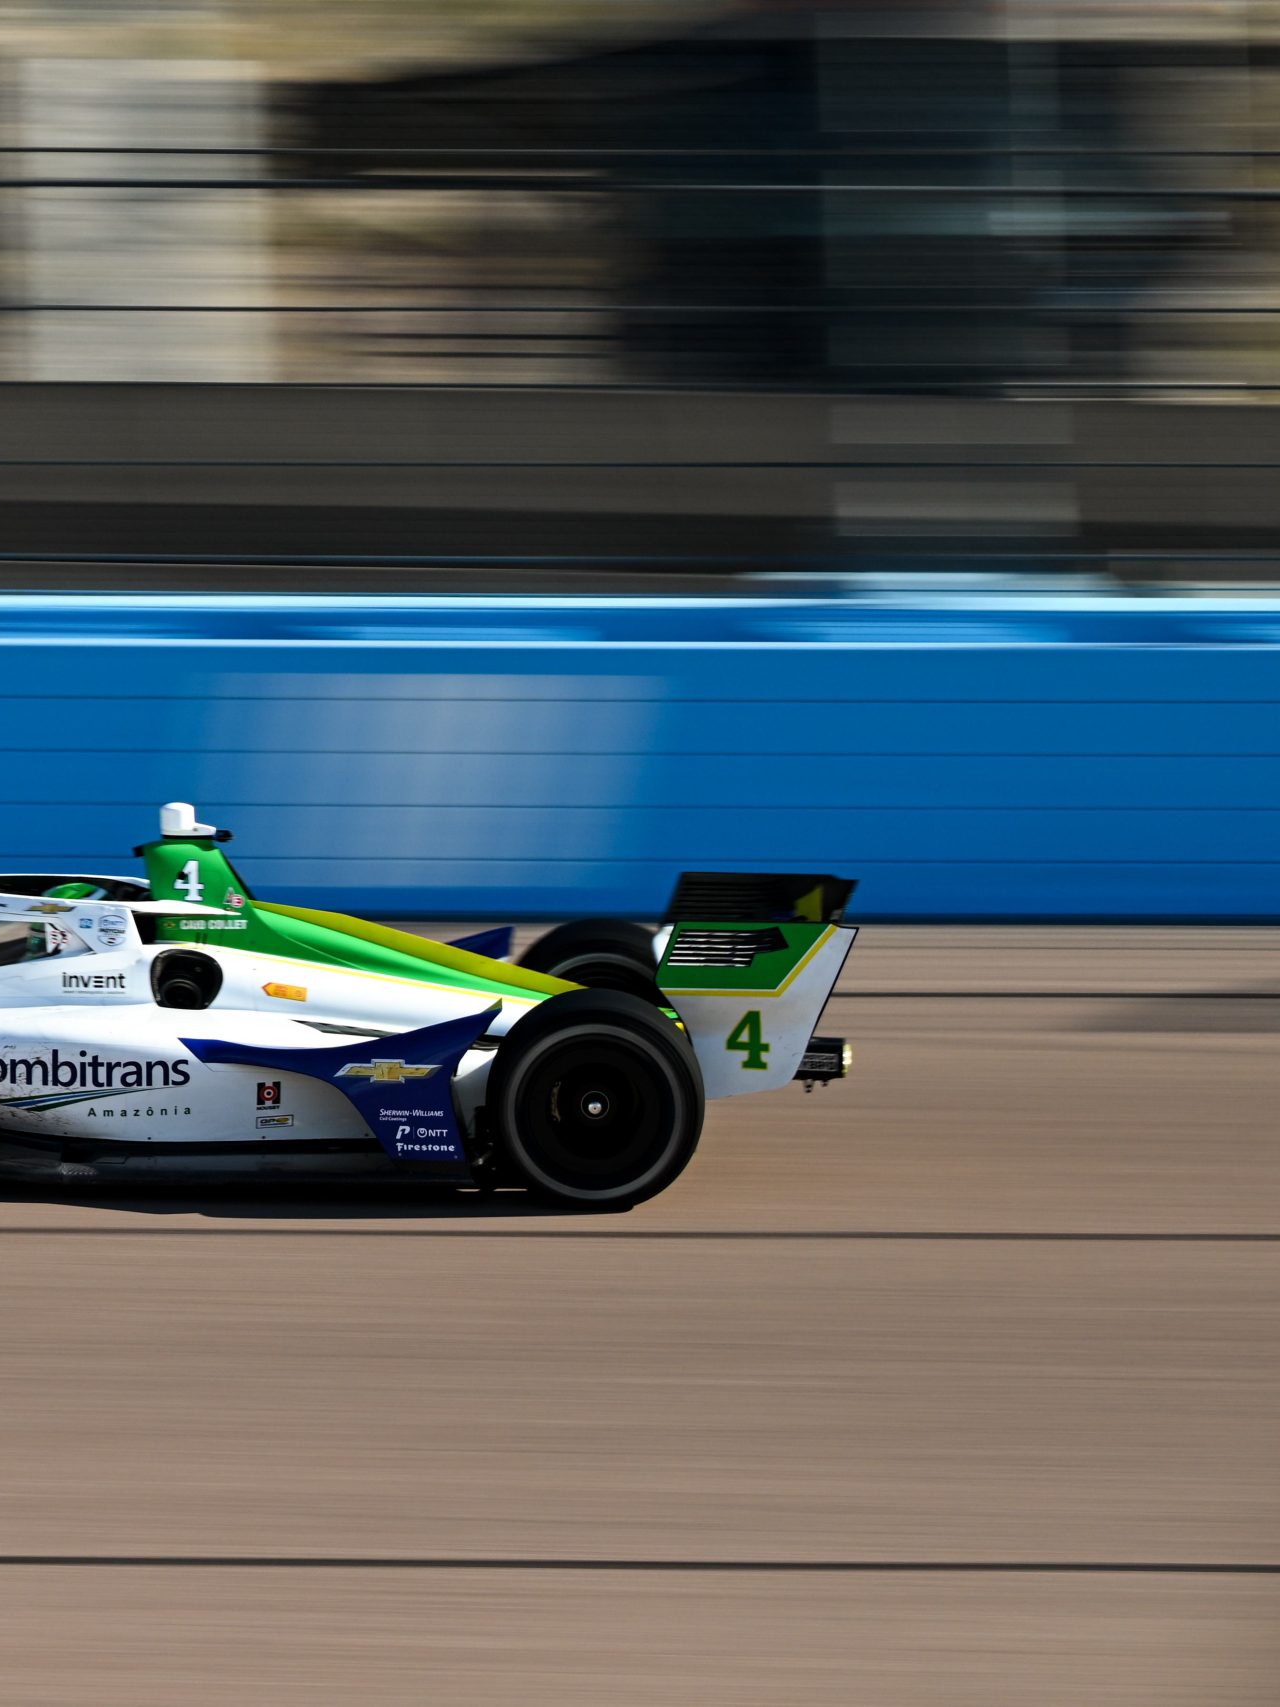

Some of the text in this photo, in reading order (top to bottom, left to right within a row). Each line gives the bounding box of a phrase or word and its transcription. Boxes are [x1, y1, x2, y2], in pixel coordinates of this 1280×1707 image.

[173, 859, 205, 901] 4
[725, 1009, 771, 1071] 4
[87, 1106, 191, 1118] Amazônia
[428, 1129, 448, 1137] NTT
[395, 1142, 455, 1152] Firestone
